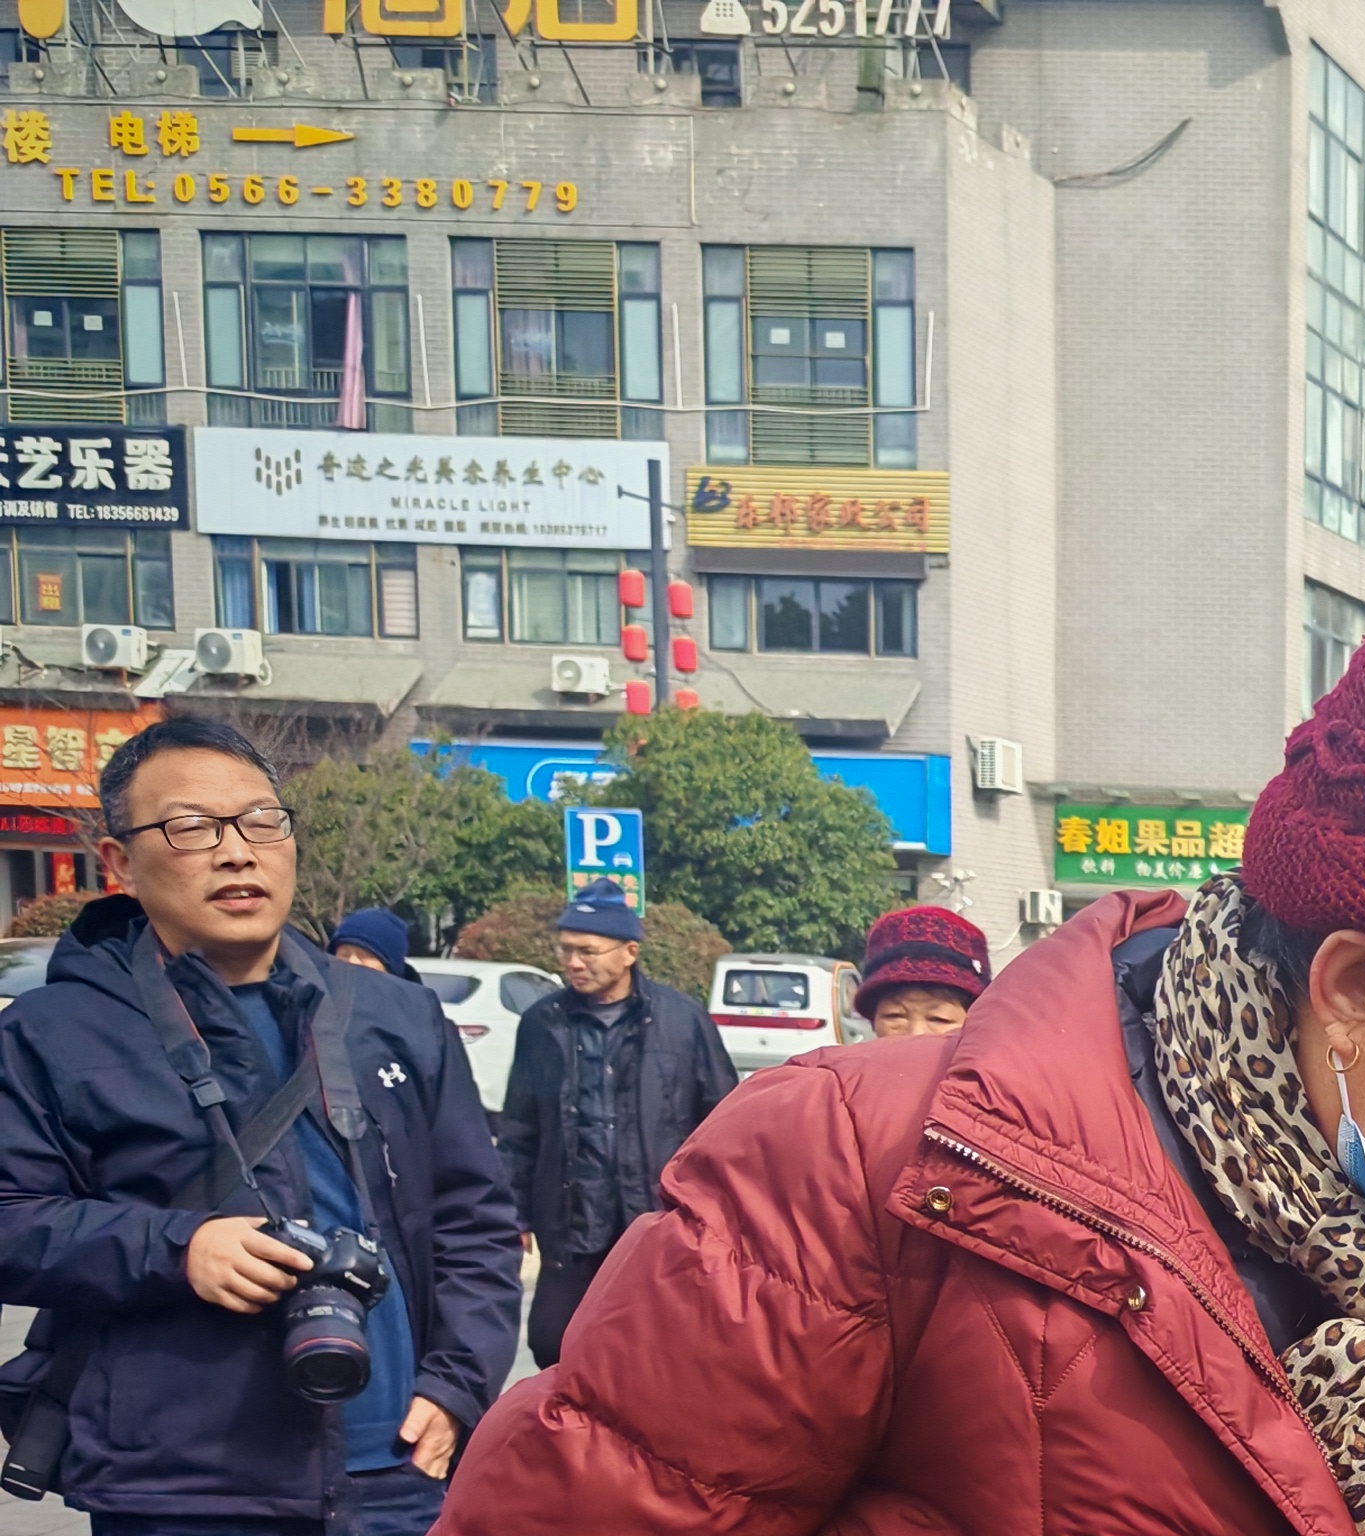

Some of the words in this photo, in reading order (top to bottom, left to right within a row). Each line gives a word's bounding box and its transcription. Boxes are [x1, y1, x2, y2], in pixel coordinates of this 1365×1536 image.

[108, 110, 200, 158] 电梯
[0, 435, 174, 491] 艺乐器
[0, 500, 58, 519] 训及销售
[391, 496, 470, 512] MIRACLE
[479, 499, 532, 514] LIGHT
[578, 813, 622, 867] P
